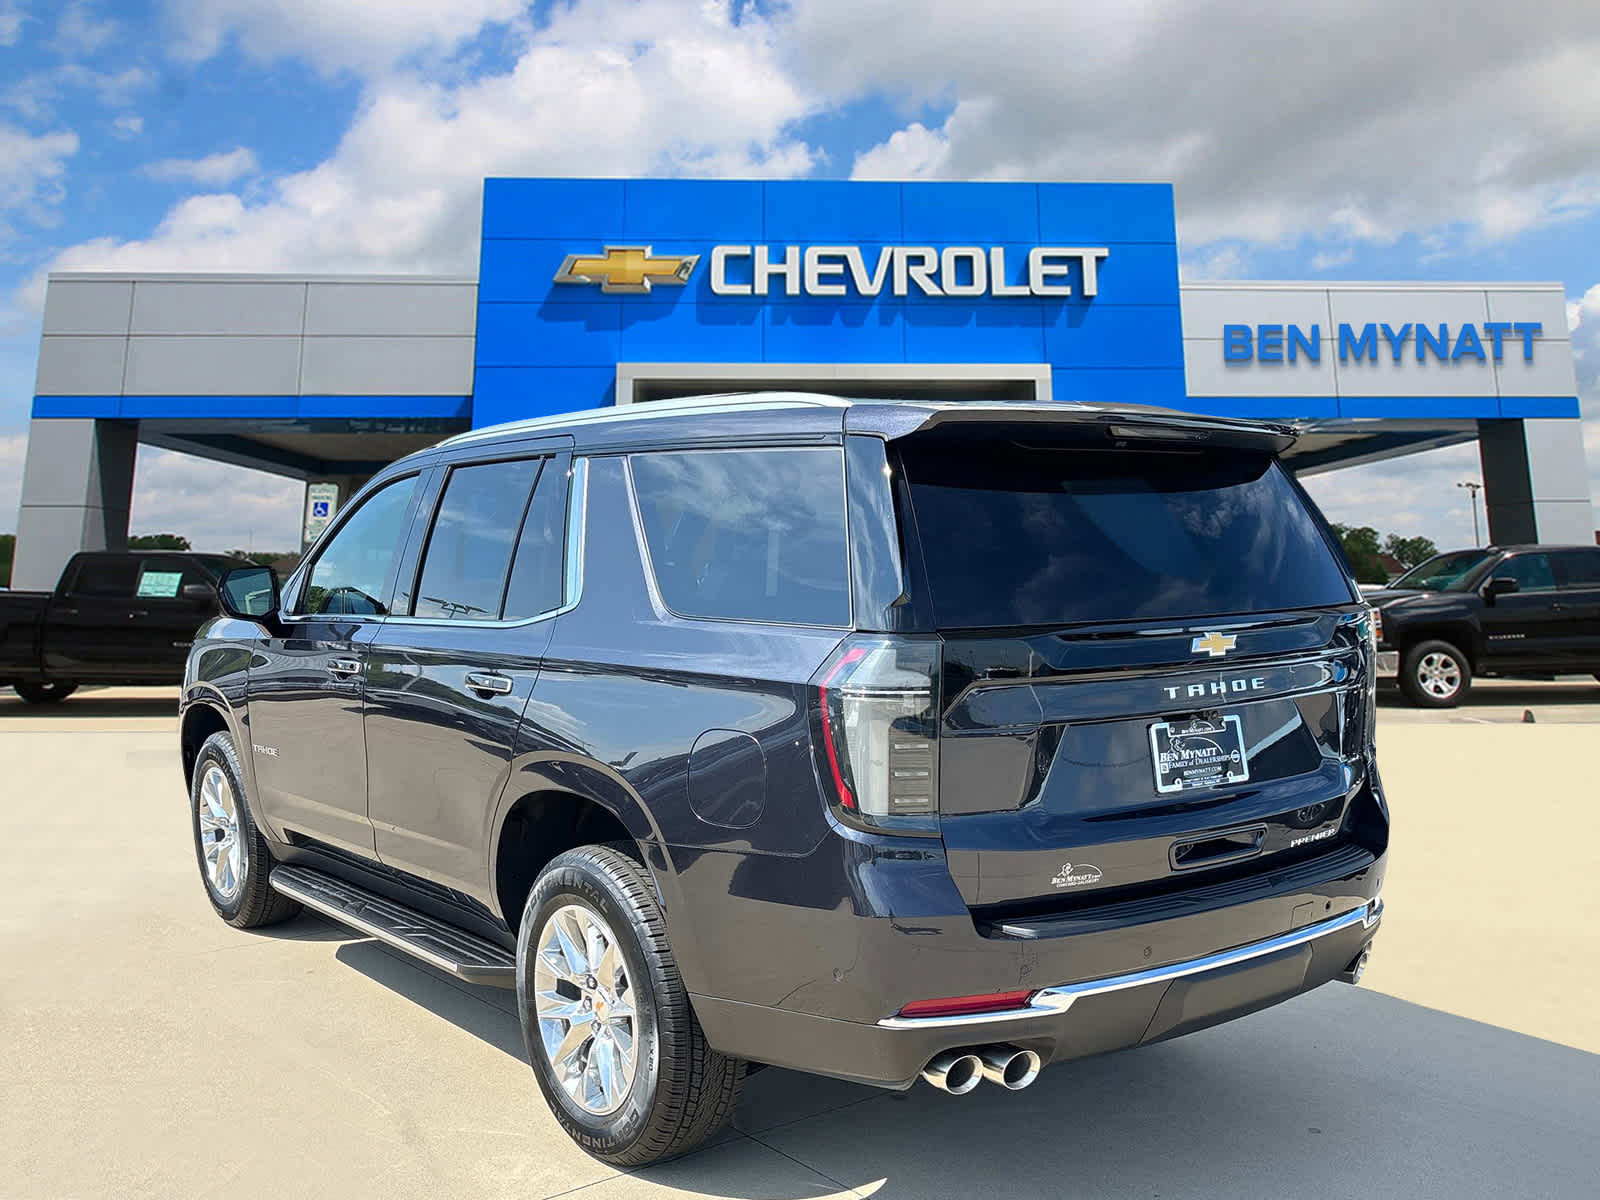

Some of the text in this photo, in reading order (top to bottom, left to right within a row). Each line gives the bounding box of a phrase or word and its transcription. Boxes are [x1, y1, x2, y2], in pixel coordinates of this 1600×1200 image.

[710, 245, 1109, 296] CHEVROLET
[1224, 322, 1543, 362] BEN MYNATT
[1163, 677, 1265, 700] TAHOE
[252, 743, 280, 759] TAHOE
[1160, 747, 1218, 763] BEN MYNATT
[1168, 760, 1188, 769] FAMILY
[1290, 828, 1337, 848] PREMIER
